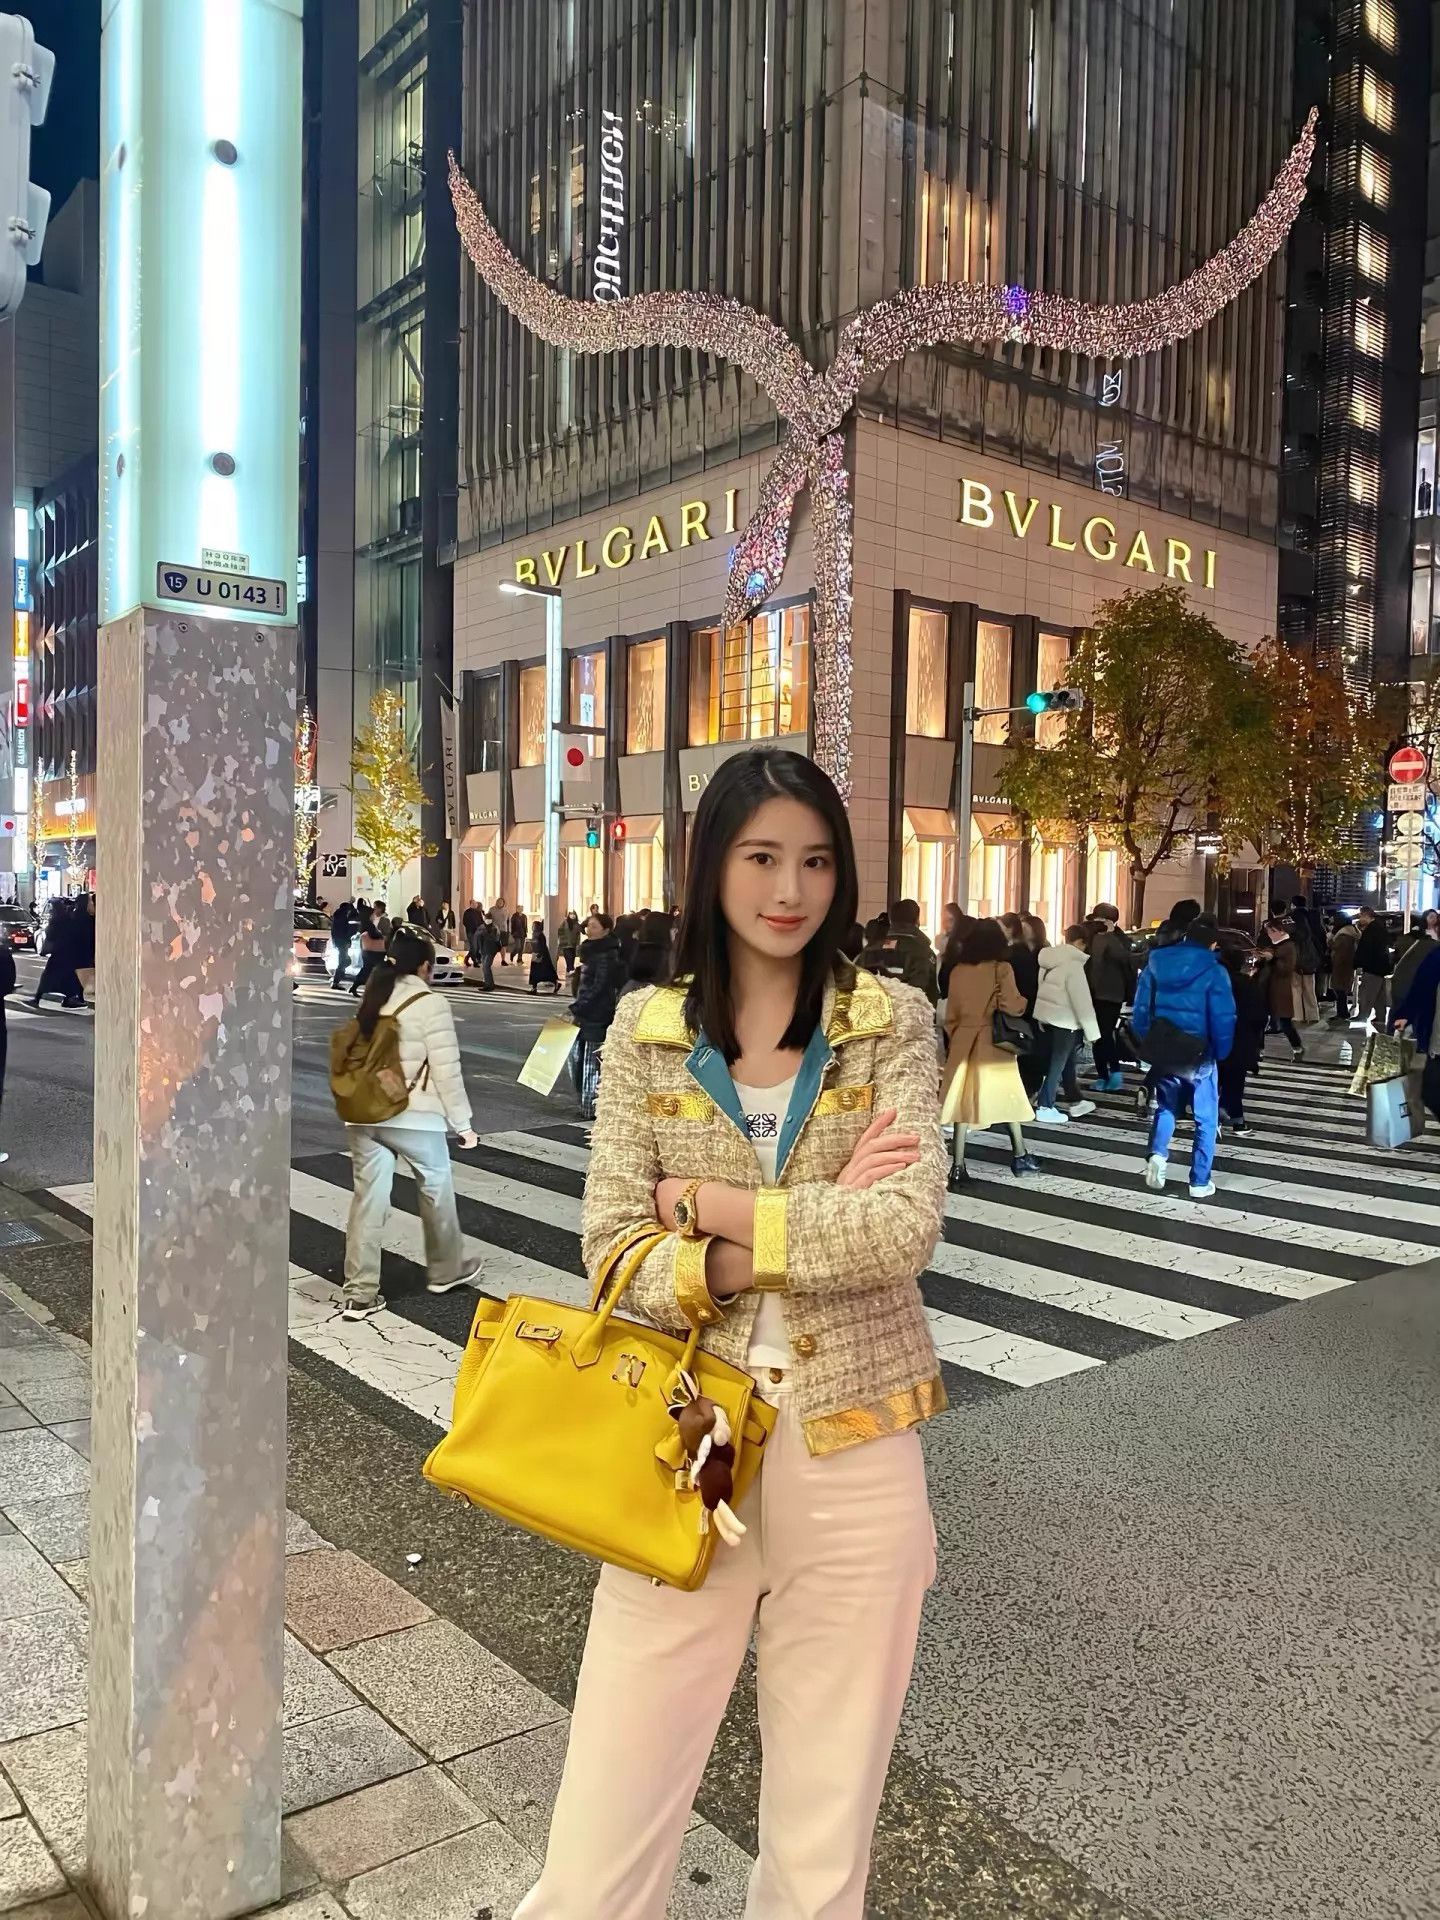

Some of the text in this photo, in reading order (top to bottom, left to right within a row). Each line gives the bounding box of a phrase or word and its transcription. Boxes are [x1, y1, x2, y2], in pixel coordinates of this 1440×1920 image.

[514, 488, 739, 587] BVLGARI
[959, 477, 1217, 589] BVLGARI
[168, 575, 183, 589] 15
[197, 578, 211, 595] U
[218, 581, 266, 604] 0143
[972, 794, 1012, 805] BVLGARI
[469, 809, 499, 821] BVLGAR
